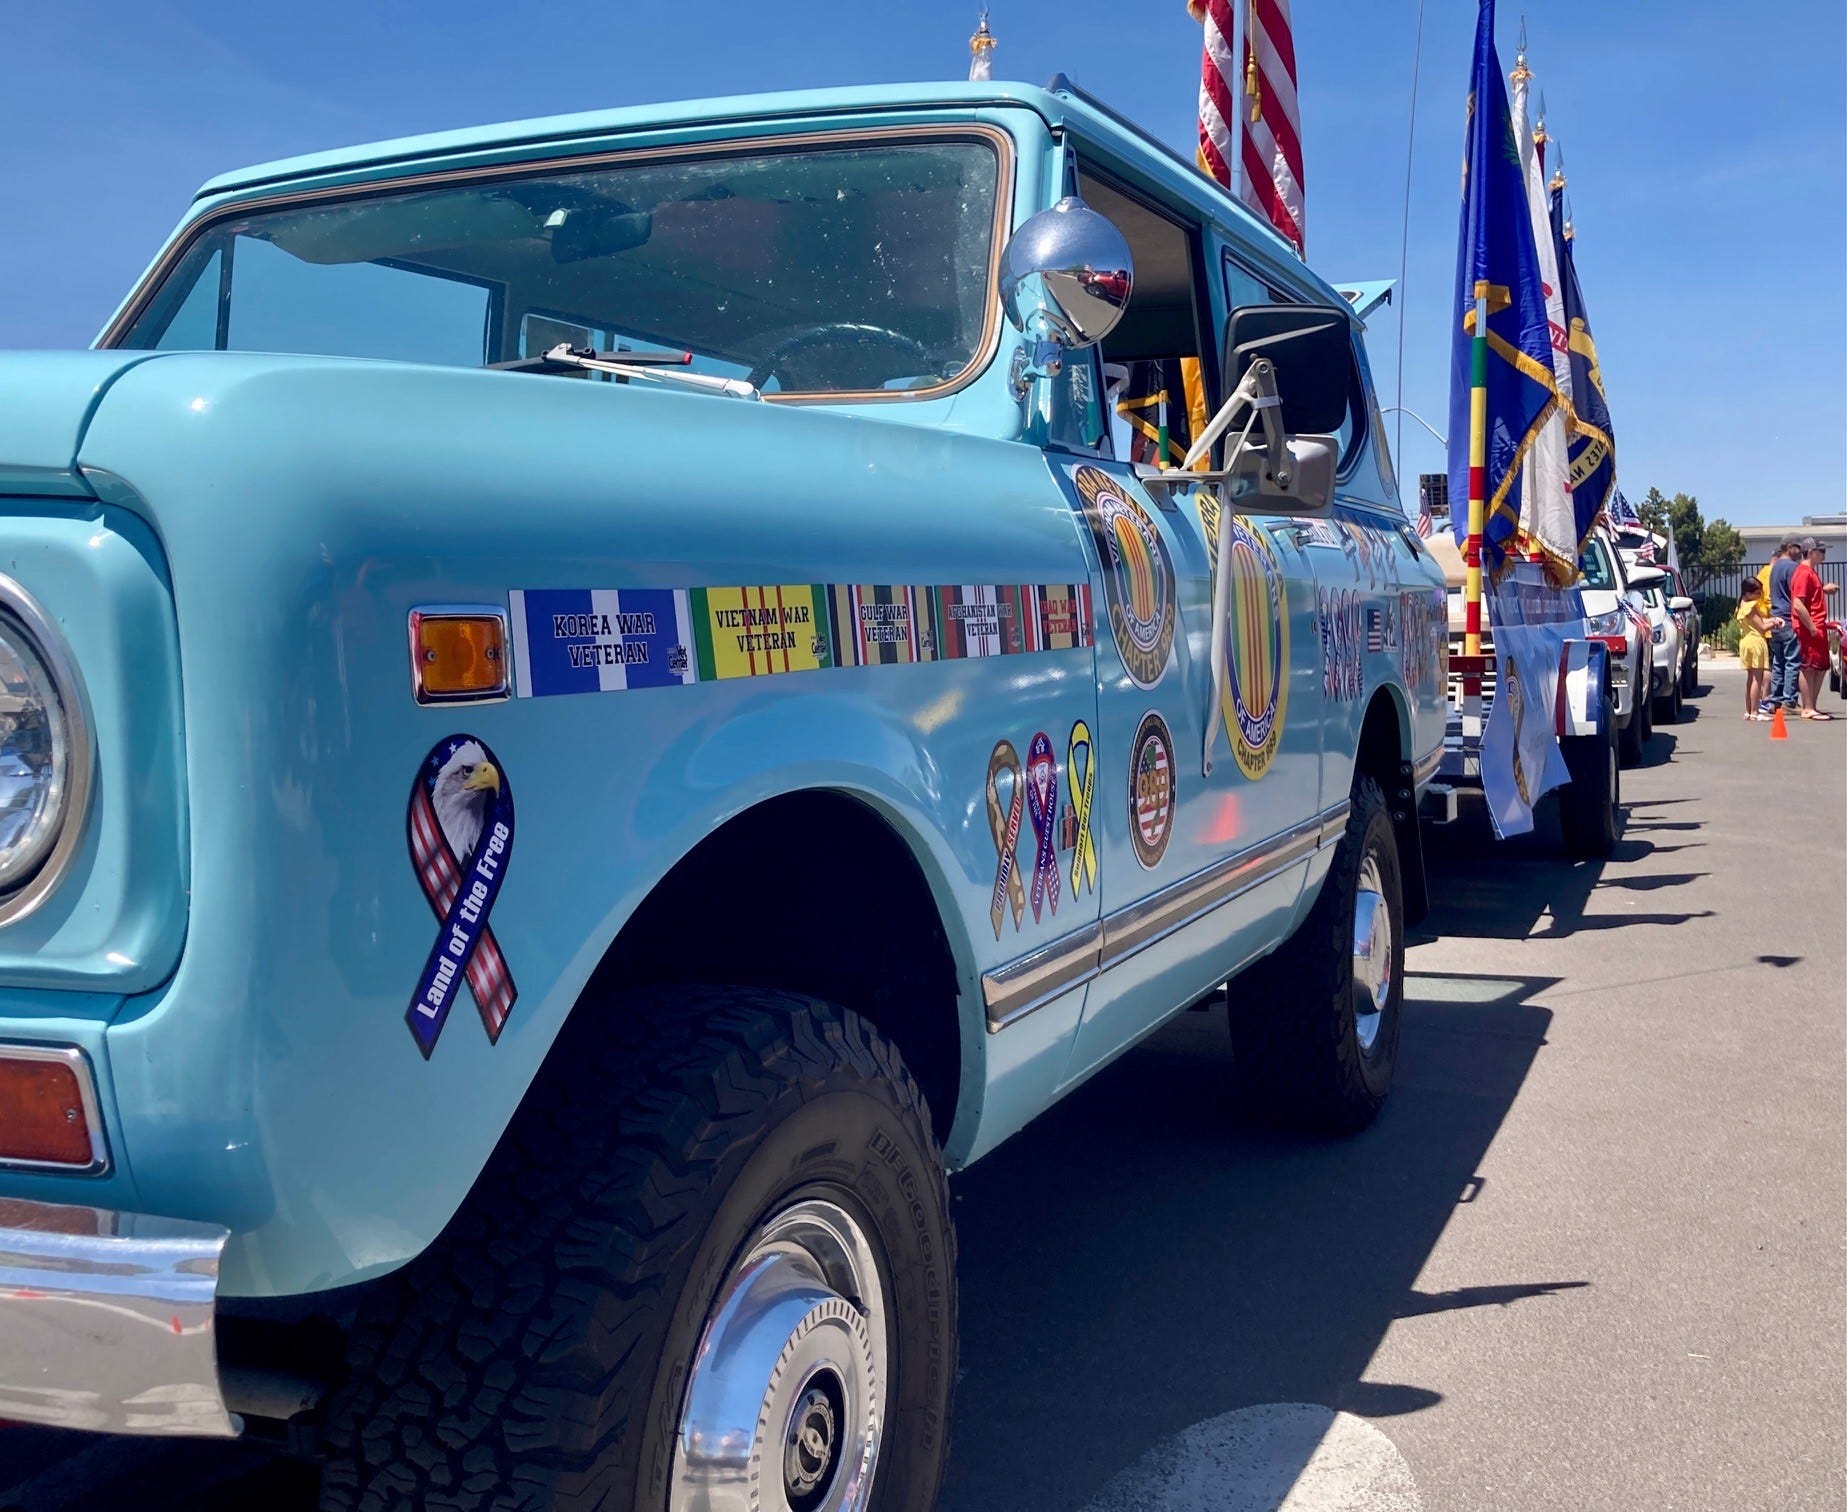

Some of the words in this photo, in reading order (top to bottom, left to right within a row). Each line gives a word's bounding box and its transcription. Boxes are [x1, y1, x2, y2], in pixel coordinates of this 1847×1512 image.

[553, 614, 612, 639] KOREA
[617, 612, 656, 636] WAR
[715, 607, 778, 629] VIETNAM
[783, 606, 809, 625] WAR
[860, 605, 884, 621] GULF
[885, 604, 909, 620] WAR
[948, 604, 996, 620] AFGHANISTAN
[996, 603, 1012, 618] WAR
[1125, 603, 1136, 625] OF
[1135, 611, 1161, 641] AMERICA
[736, 631, 796, 653] VETERAN
[865, 626, 908, 642] VETERAN
[966, 622, 999, 637] VETERAN
[1112, 603, 1161, 680] CHAPTER
[567, 641, 650, 669] VETERAN
[1236, 698, 1246, 725] OF
[1245, 702, 1276, 743] AMERICA
[1237, 737, 1266, 772] CHAPTER
[1046, 777, 1057, 815] HOUSE
[1042, 817, 1053, 850] GUEST
[995, 847, 1012, 912] PROUDLY
[1008, 794, 1022, 851] SERVED
[1034, 850, 1048, 905] VETERANS
[416, 954, 458, 1020] Land
[448, 921, 471, 958] of
[460, 879, 488, 924] the
[475, 821, 510, 880] Free
